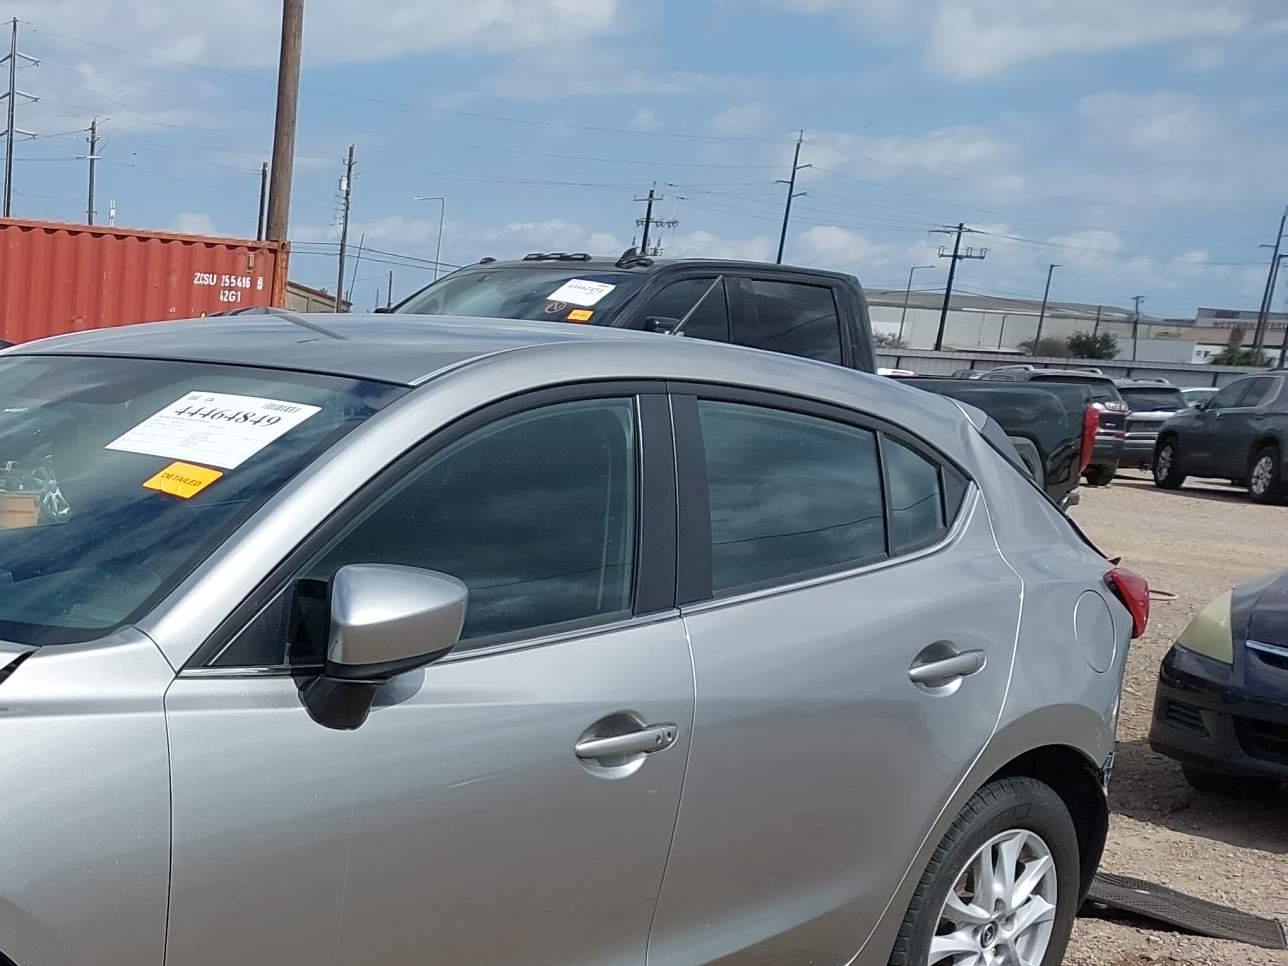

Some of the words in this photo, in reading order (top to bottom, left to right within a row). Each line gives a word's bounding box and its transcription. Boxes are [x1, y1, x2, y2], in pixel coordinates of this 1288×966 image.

[194, 272, 217, 286] ZCSU
[175, 405, 282, 427] 44464849
[161, 472, 202, 487] DETAILED
